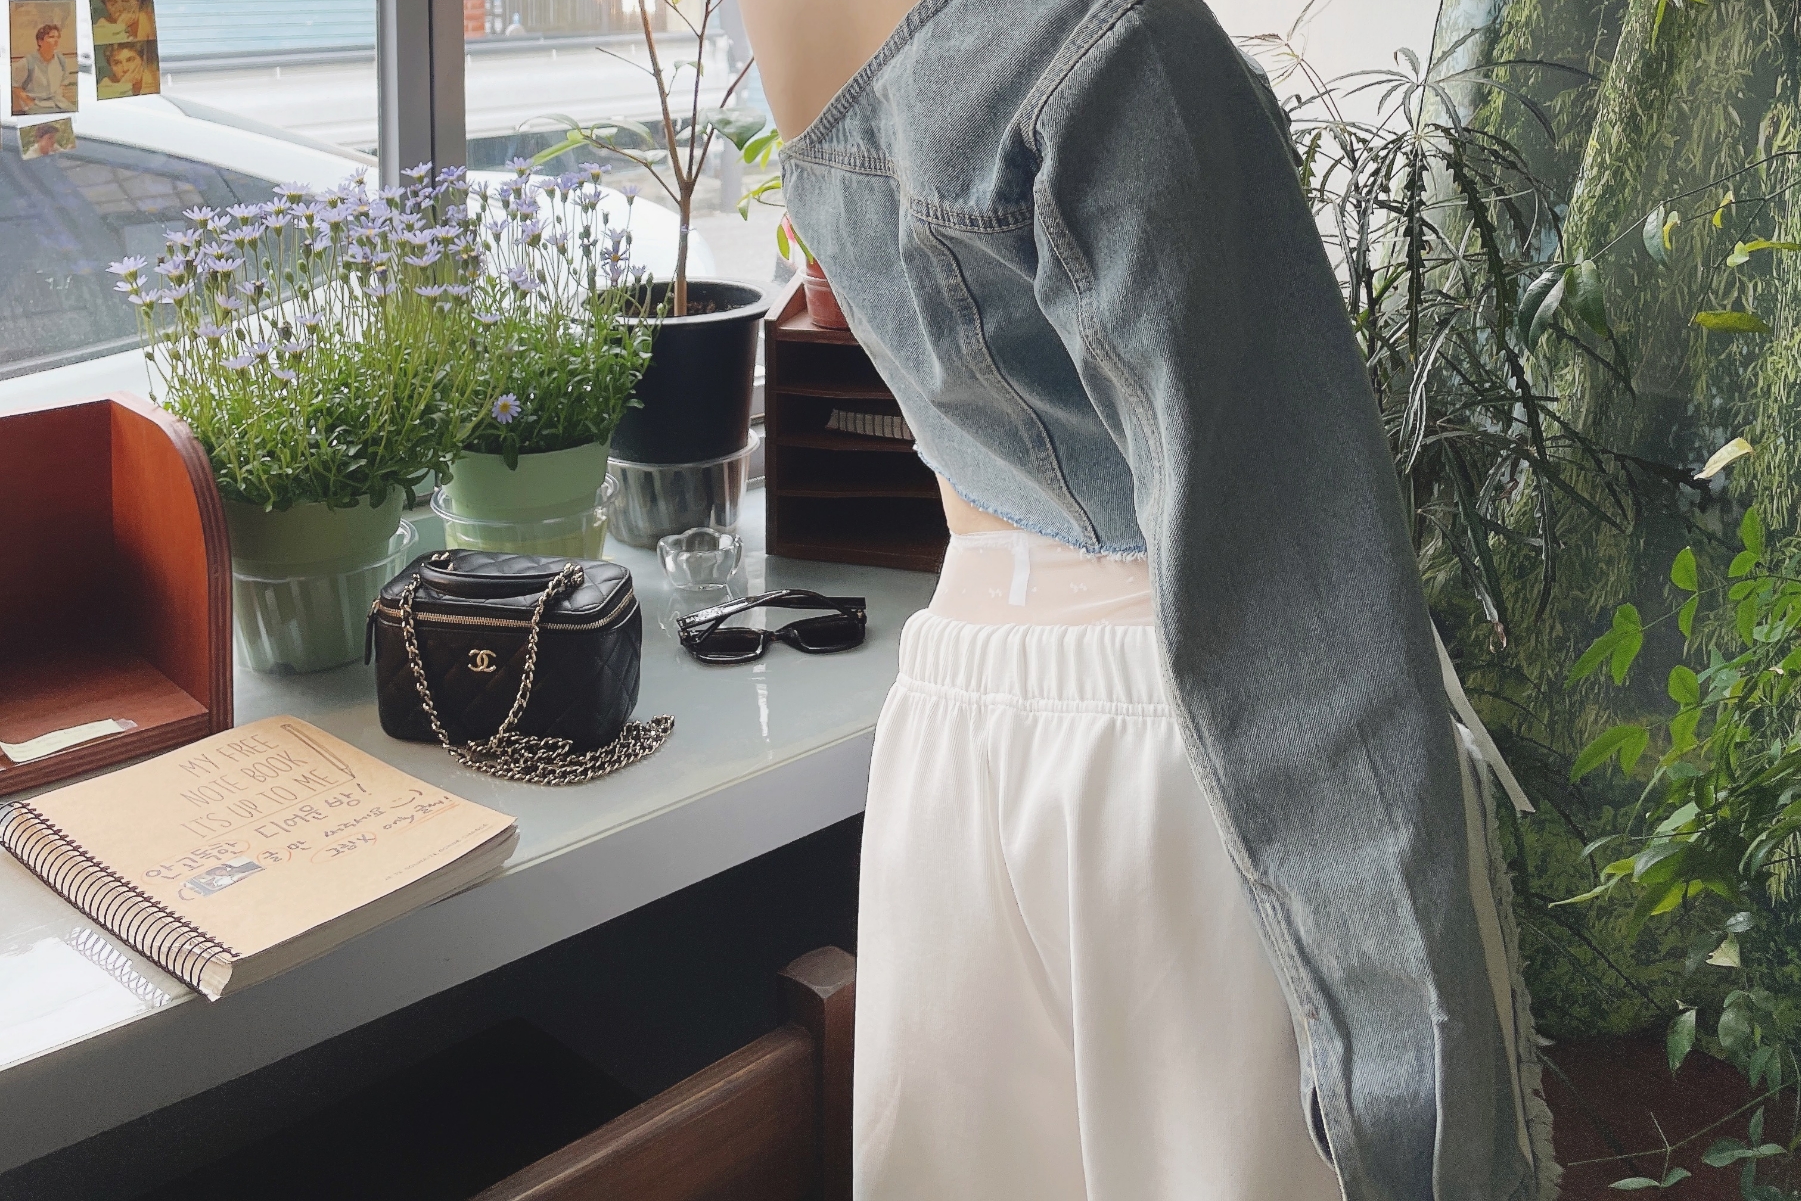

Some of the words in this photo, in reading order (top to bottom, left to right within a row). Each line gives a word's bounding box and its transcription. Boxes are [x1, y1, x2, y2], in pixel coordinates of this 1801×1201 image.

[178, 753, 221, 779] MY
[215, 733, 280, 763] FREE
[179, 774, 249, 808] NOTE
[240, 750, 309, 783] BOOK
[180, 812, 232, 839] IT'S
[226, 799, 263, 819] UP
[255, 785, 298, 805] TO
[293, 768, 340, 792] ME
